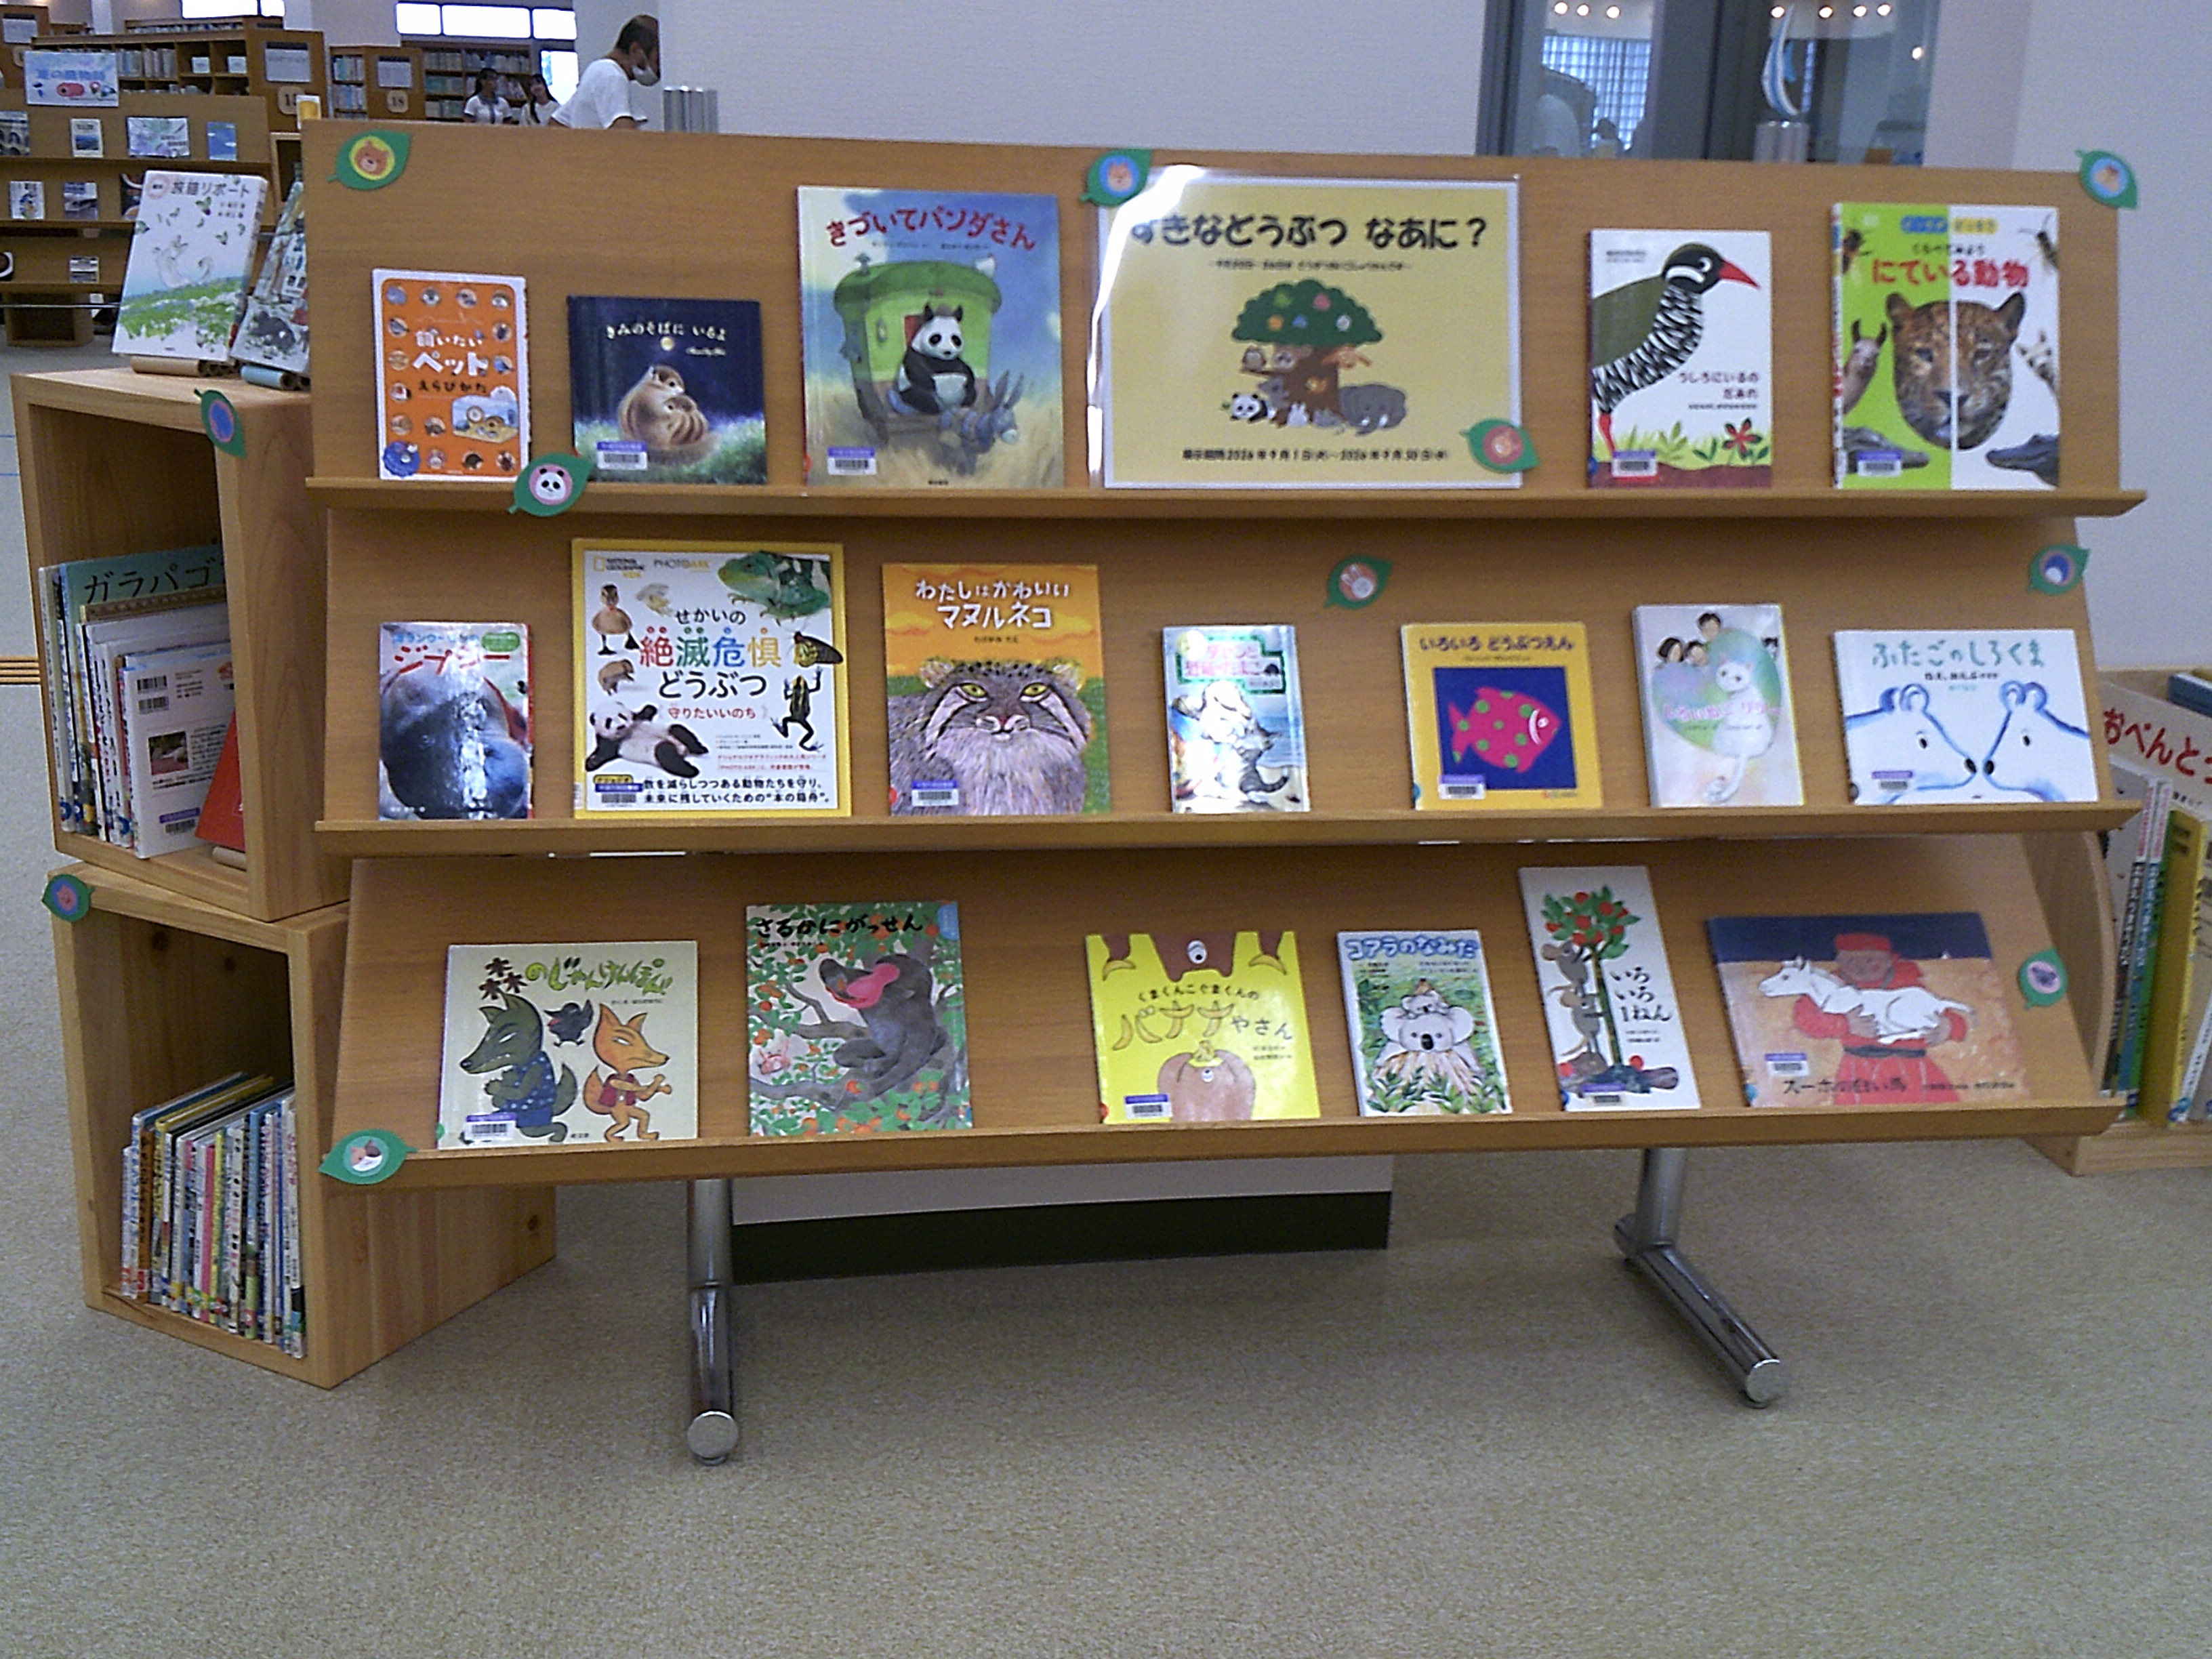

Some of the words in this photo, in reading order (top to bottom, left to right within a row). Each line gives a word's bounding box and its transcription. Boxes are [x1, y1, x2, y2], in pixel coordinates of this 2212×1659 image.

[826, 203, 1036, 251] きづいてパンダさん
[1365, 218, 1488, 250] なあに？
[1872, 260, 2029, 288] にている動物
[606, 321, 684, 340] きみのそばに
[692, 326, 726, 342] いるよ
[412, 350, 489, 377] ペット
[419, 380, 486, 394] えらびかた
[84, 556, 225, 604] ガラパゴ
[916, 580, 1070, 603] わたしはかわいい
[676, 608, 747, 625] せかいの
[937, 601, 1052, 630] マヌルネコ
[640, 634, 782, 668] 絶滅危惧
[1420, 636, 1482, 652] いろいろ
[1488, 635, 1574, 652] どうぶつえん
[1872, 638, 2045, 668] ふたごのしろくま
[658, 669, 767, 699] どうぶつ
[2103, 708, 2212, 785] おべんと
[755, 914, 923, 939] さるかにがっせん
